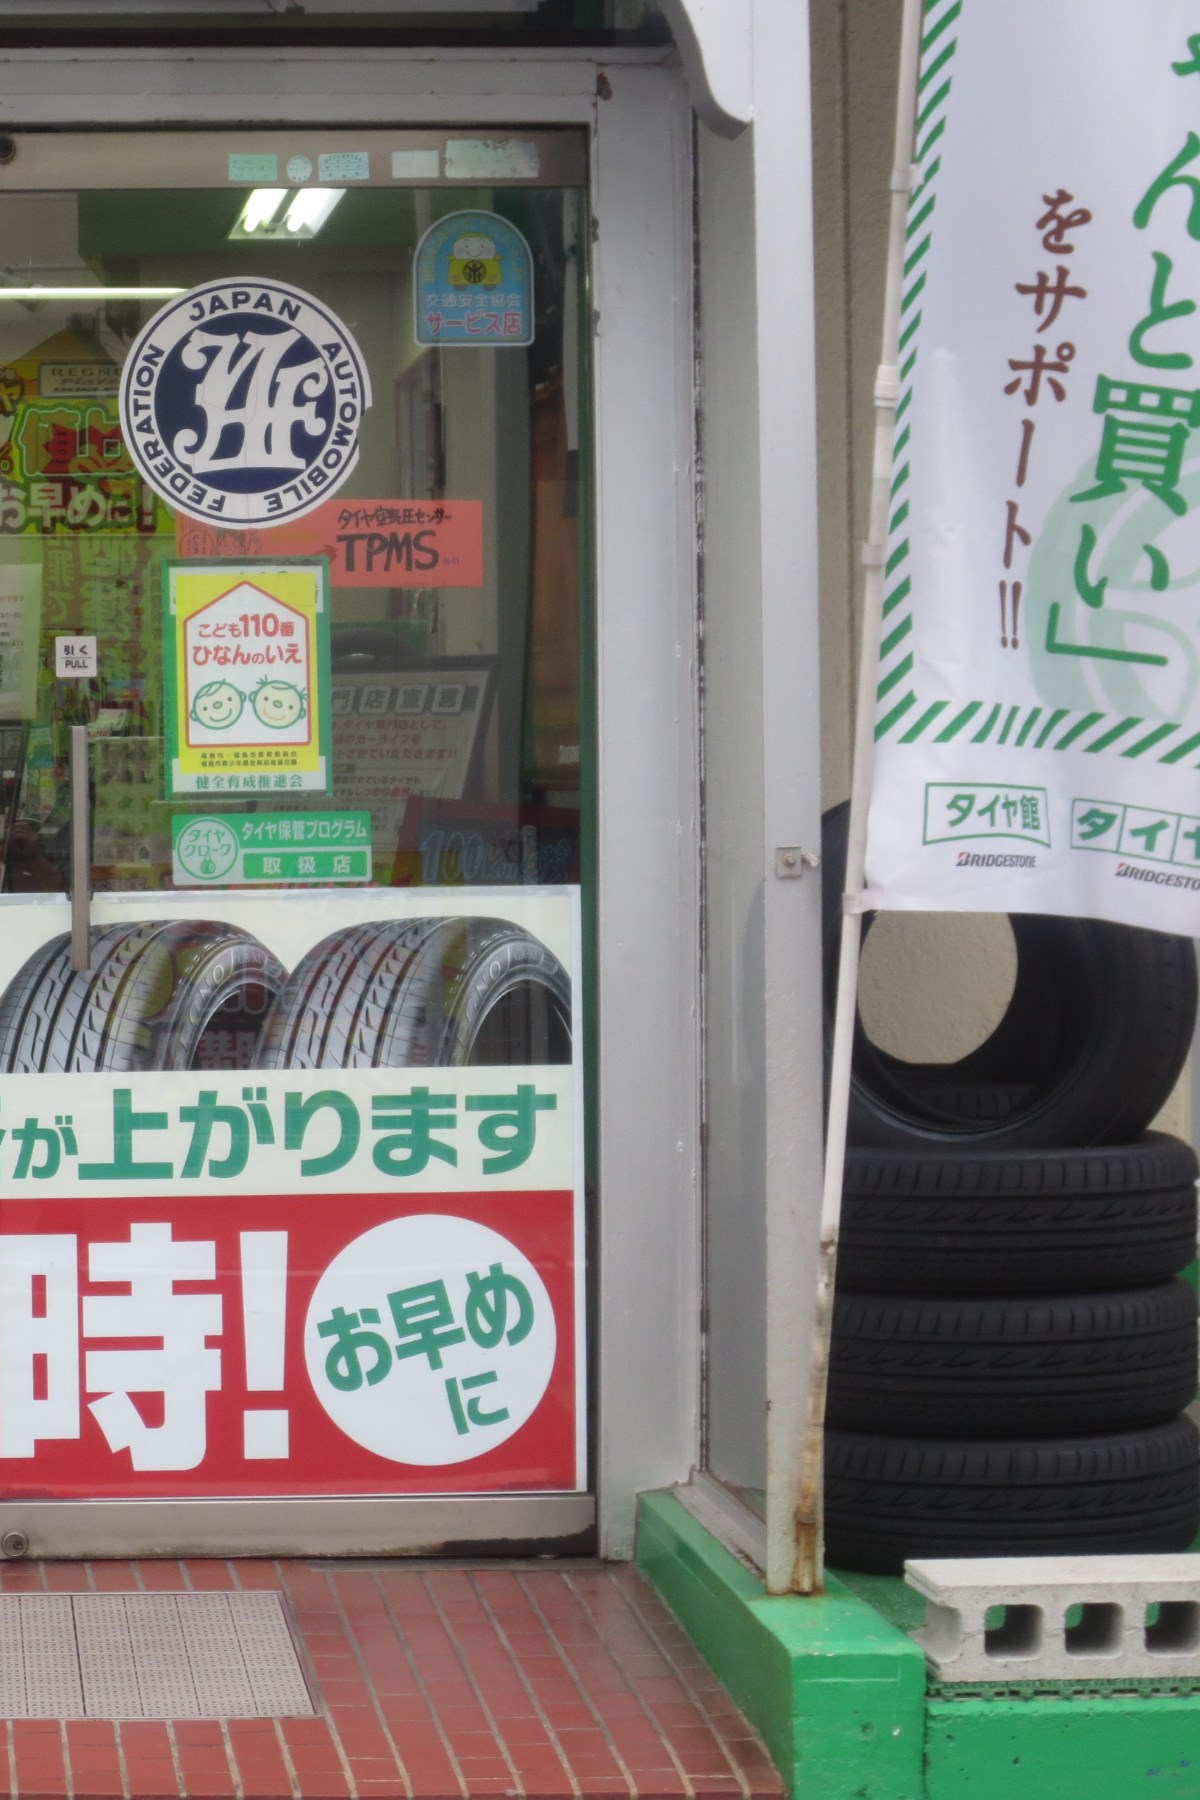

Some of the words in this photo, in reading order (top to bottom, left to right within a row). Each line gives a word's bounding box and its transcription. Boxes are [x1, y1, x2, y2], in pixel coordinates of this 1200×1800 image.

[189, 291, 301, 322] JAPAN
[426, 311, 522, 336] サービス店
[133, 345, 227, 513] FEDERATION
[263, 341, 357, 513] AUTOMOBILE
[337, 530, 440, 572] TPMS
[198, 613, 295, 638] こども110番
[64, 645, 88, 656] 引く
[193, 644, 303, 665] ひなんのいえ
[65, 660, 88, 669] PULL
[946, 793, 1040, 831] タイヤ館
[242, 821, 367, 841] タイヤ保管プログラム
[263, 856, 352, 874] 取扱店
[956, 851, 1037, 868] BRIDGESTONE
